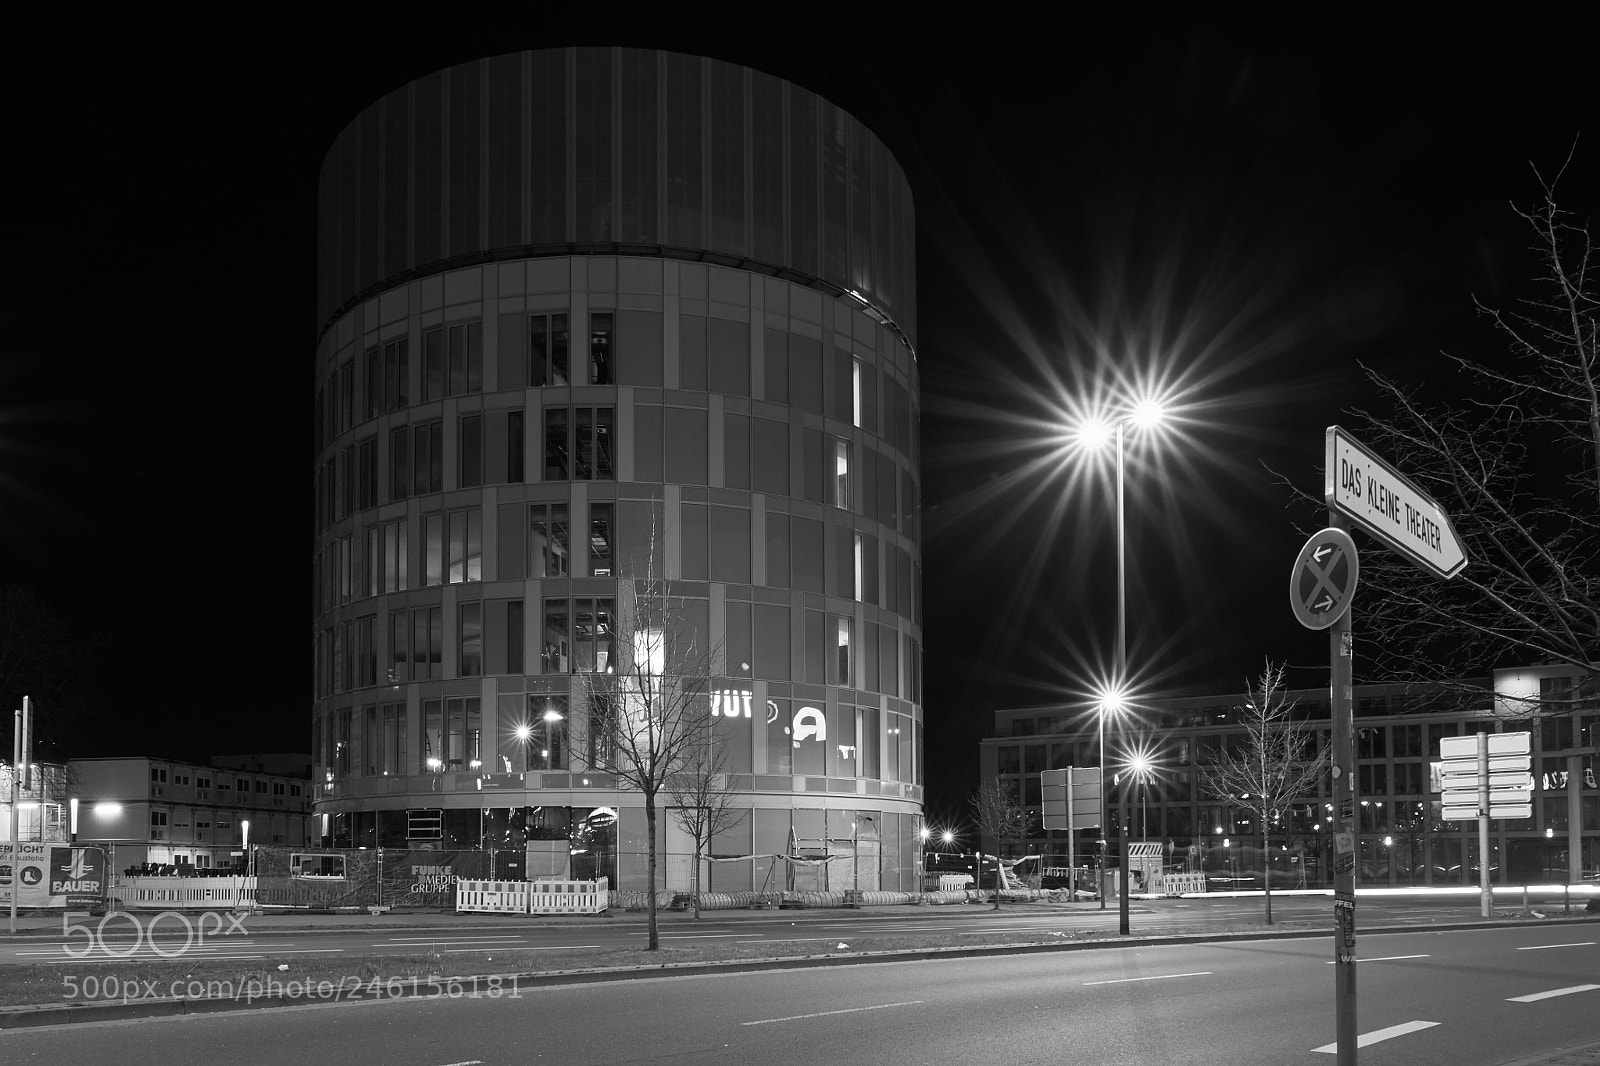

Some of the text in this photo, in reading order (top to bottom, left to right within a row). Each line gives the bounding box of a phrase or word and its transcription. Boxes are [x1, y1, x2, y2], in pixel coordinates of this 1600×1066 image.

[1341, 458, 1442, 554] DAS KLEINE THEATER
[411, 865, 452, 875] FUNKE
[53, 881, 100, 893] BAUER
[411, 883, 450, 893] GRUPPE
